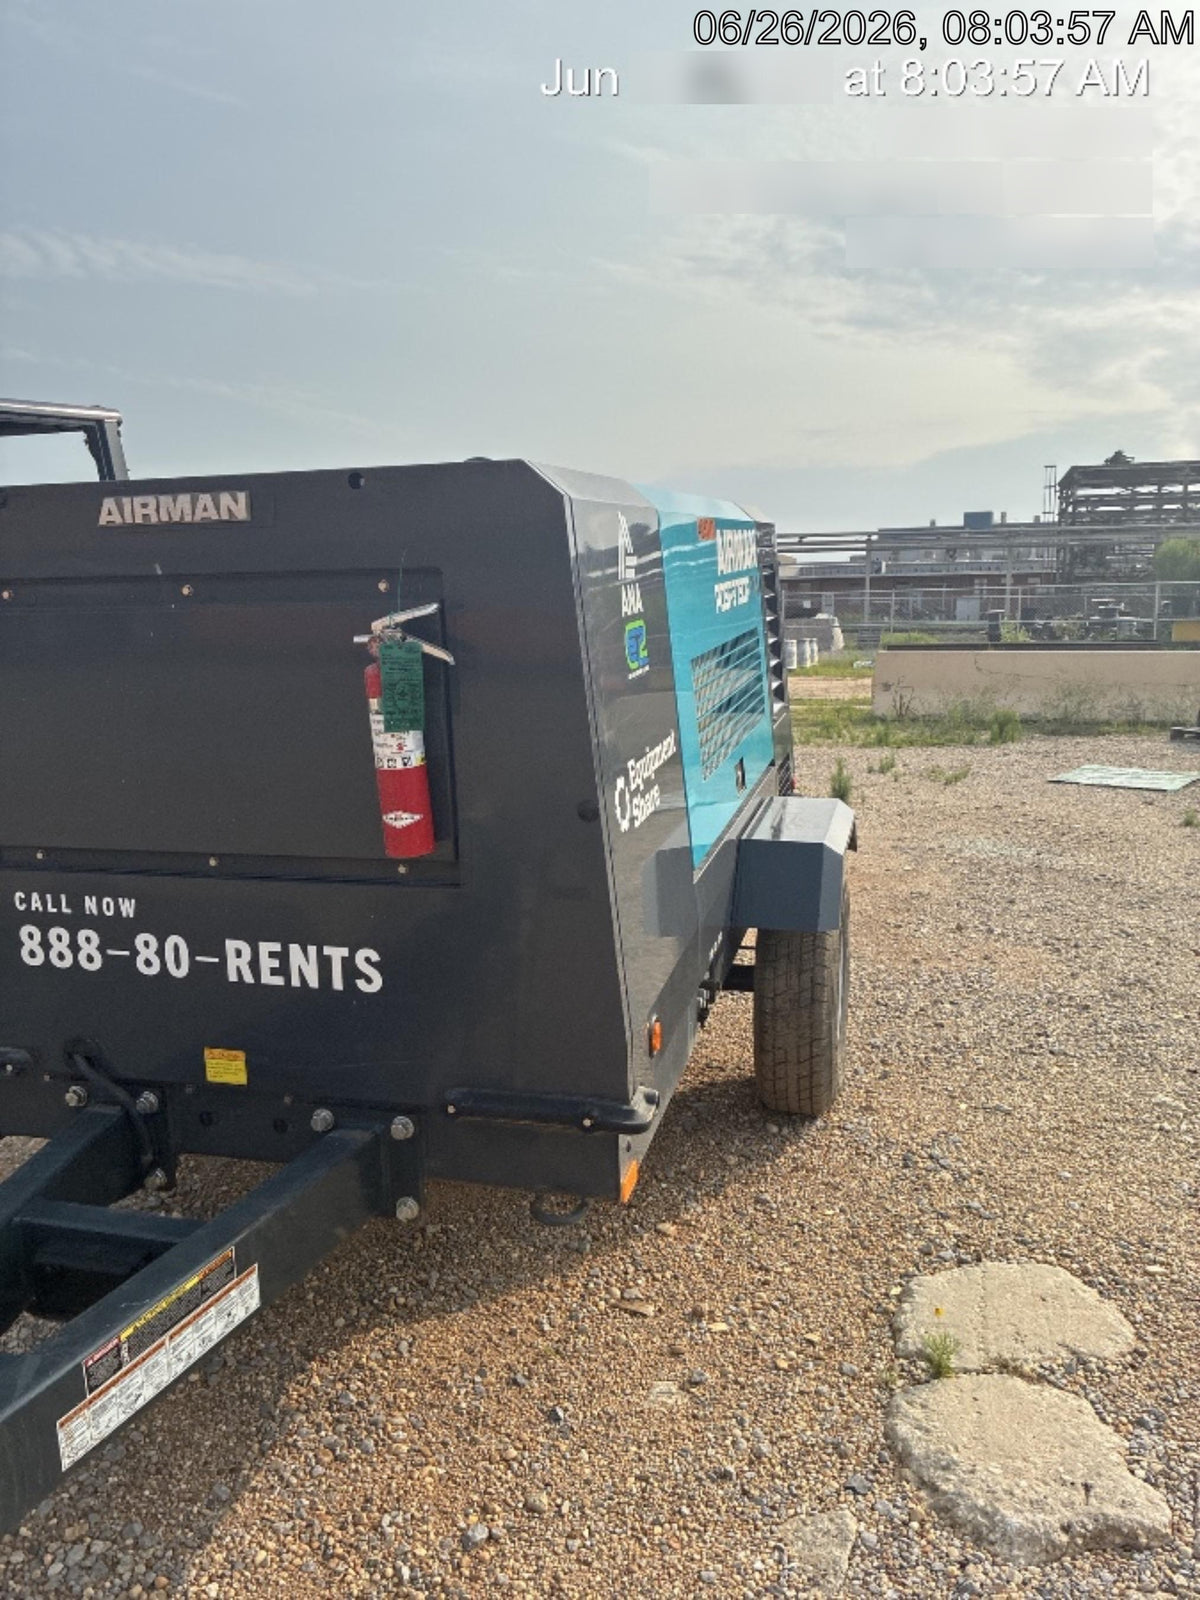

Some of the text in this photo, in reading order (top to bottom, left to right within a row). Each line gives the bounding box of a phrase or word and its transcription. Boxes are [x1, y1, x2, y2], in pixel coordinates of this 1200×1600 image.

[99, 491, 247, 526] AIRMAN
[14, 891, 136, 918] CALL NOW
[19, 924, 383, 993] 888-80-RENTS
